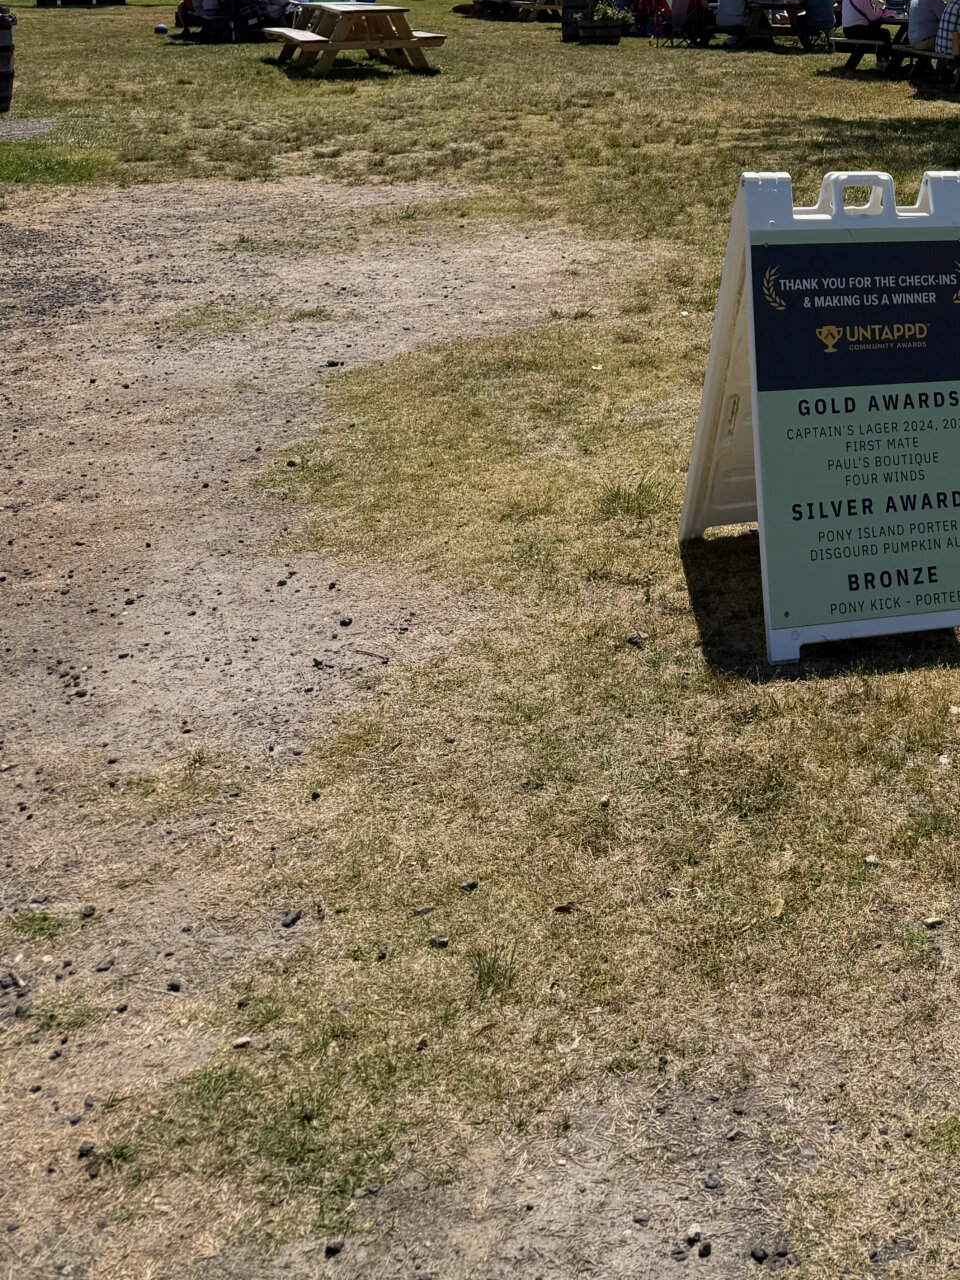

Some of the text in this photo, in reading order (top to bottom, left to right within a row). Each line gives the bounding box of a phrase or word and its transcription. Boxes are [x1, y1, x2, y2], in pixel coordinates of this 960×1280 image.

[779, 274, 957, 291] THANK YOU FOR THE CHECK-INS
[803, 292, 936, 307] & MAKING US A WINNER
[849, 343, 894, 351] COMMUNITY
[798, 391, 960, 416] GOLD AWARDS
[787, 424, 854, 439] CAPTAIN'S
[859, 422, 899, 435] LAGER
[903, 420, 938, 432] 2024,
[846, 437, 919, 452] FIRST MATE
[827, 452, 939, 470] PAUL'S BOUTIQUE
[845, 470, 925, 486] FOUR WINDS
[792, 498, 874, 521] SILVER
[818, 520, 958, 542] PONY ISLAND PORTER
[810, 544, 878, 561] DISGOURD
[884, 538, 941, 554] PUMPKIN
[848, 566, 938, 591] BRONZE
[830, 601, 865, 615] PONY
[871, 597, 901, 611] KICK
